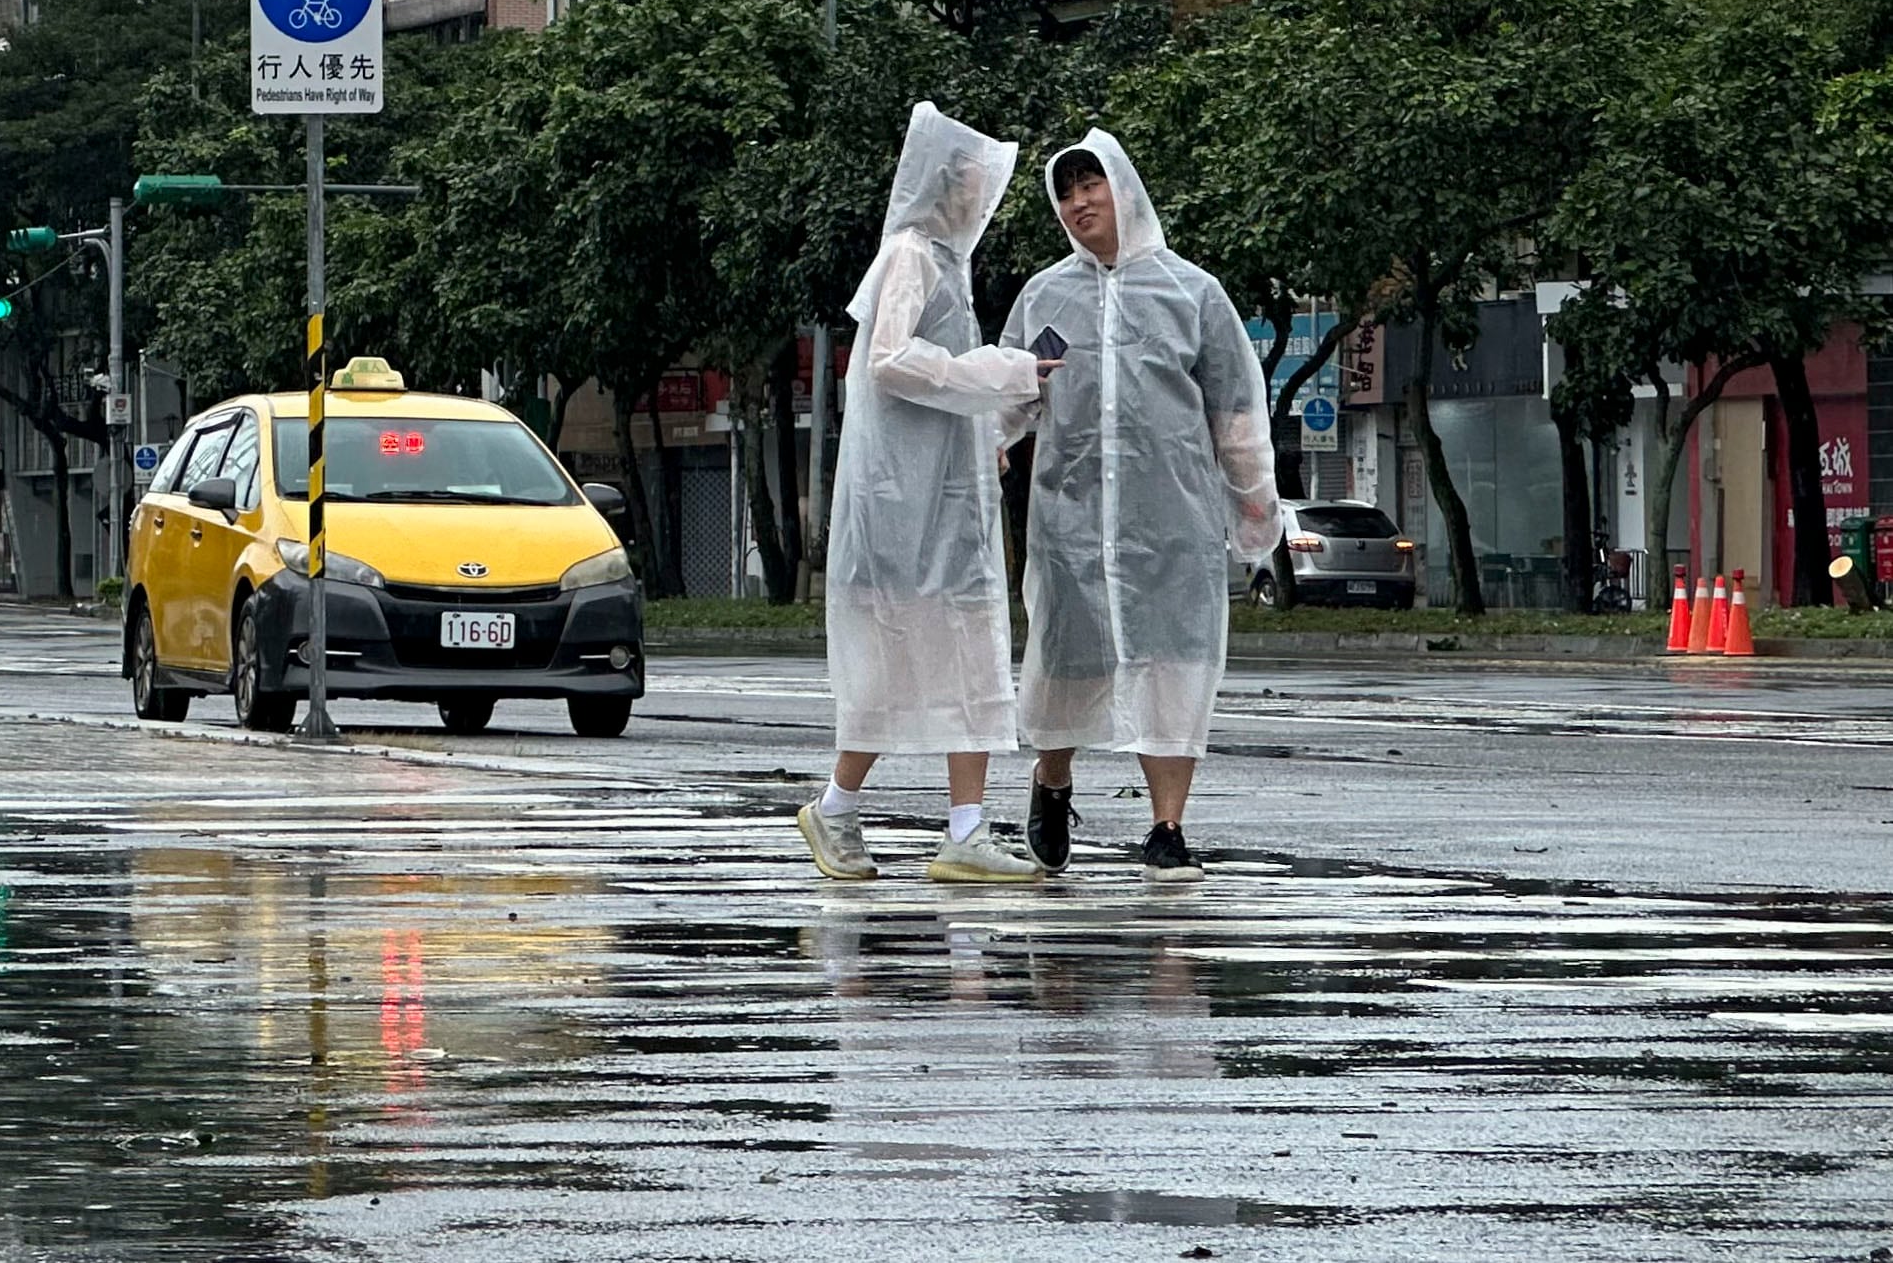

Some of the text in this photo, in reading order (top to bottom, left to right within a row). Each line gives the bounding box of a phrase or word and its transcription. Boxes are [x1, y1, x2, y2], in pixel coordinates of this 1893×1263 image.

[257, 54, 374, 80] 行人優先
[256, 88, 375, 105] Pedestrians Have Right of Way
[448, 620, 511, 644] 116-6D
